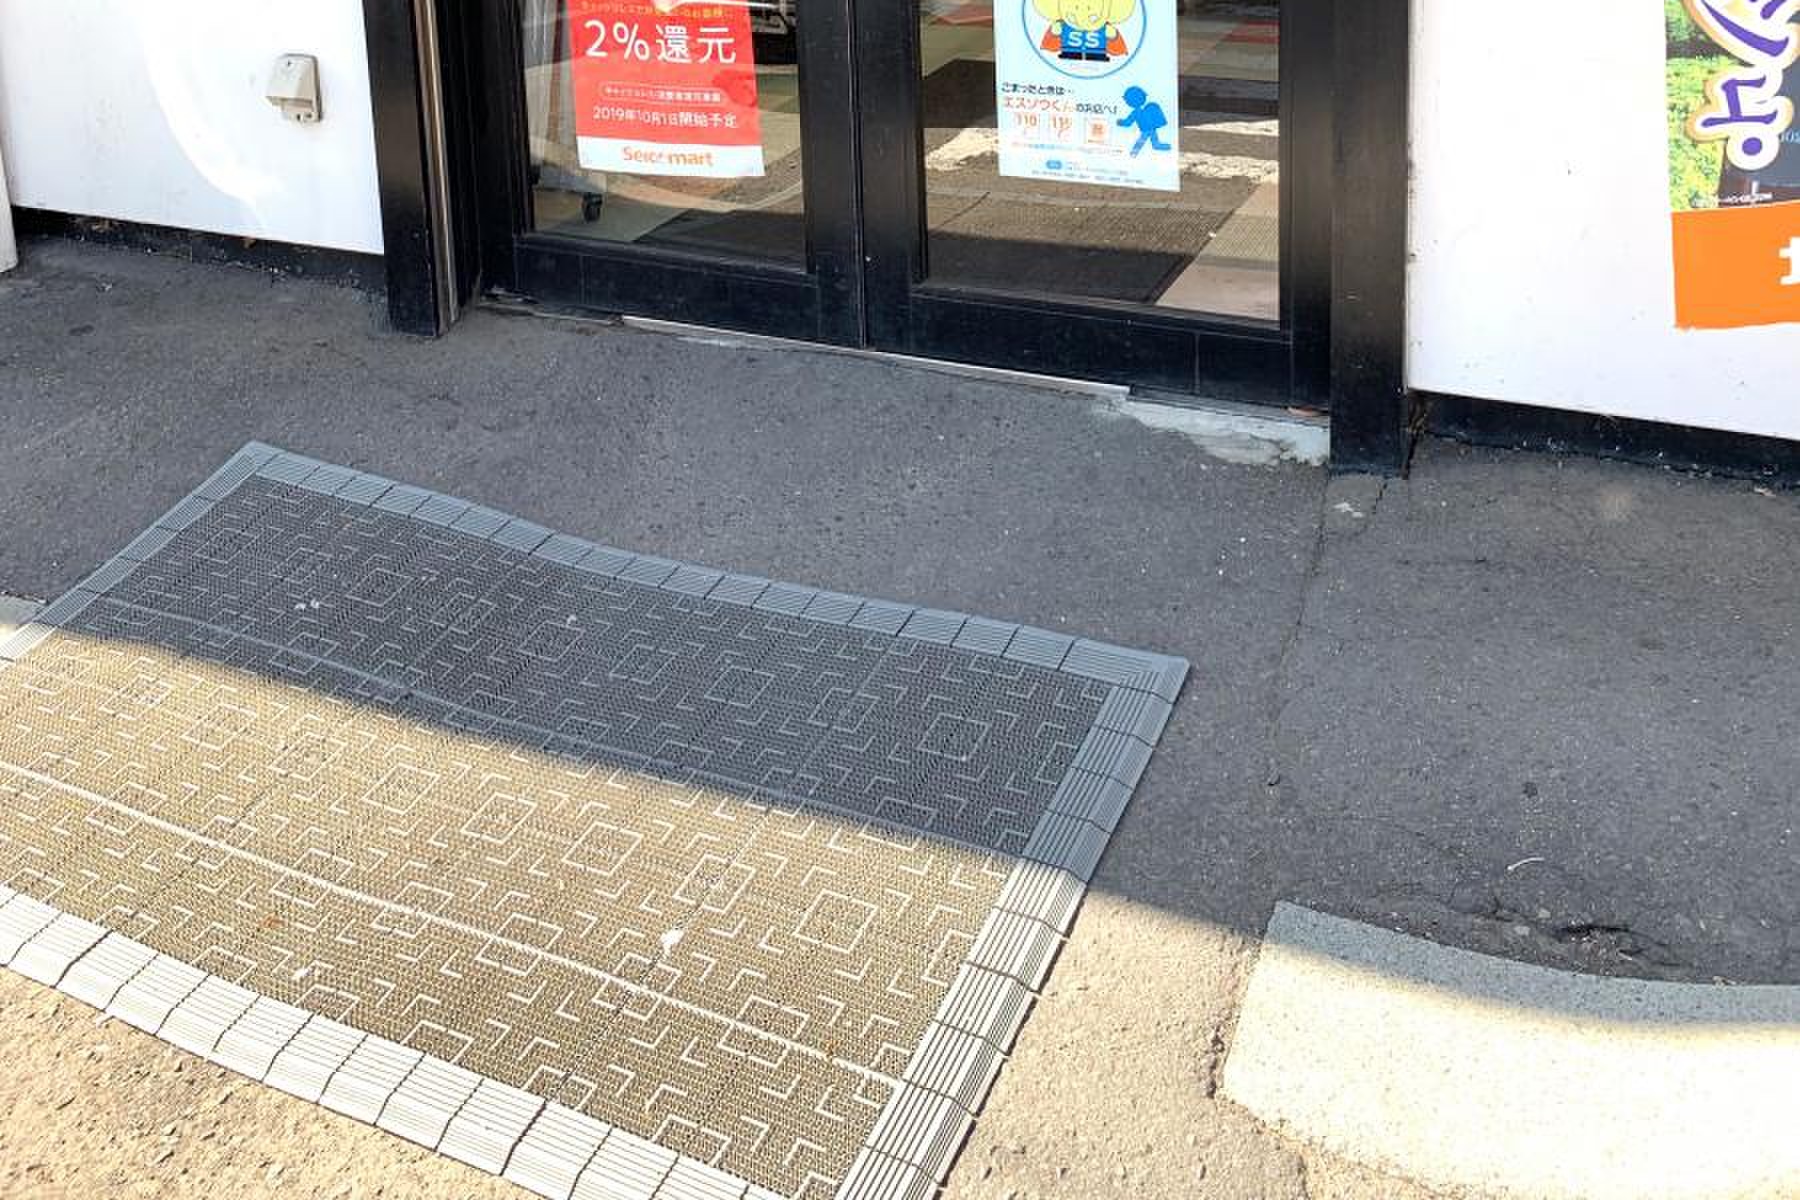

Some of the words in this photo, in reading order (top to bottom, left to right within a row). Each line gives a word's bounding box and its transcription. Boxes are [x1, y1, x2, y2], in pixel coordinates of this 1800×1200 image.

[584, 19, 737, 64] 2%還元
[1067, 31, 1100, 48] SS
[592, 104, 739, 129] 2019年10月1日開始予定
